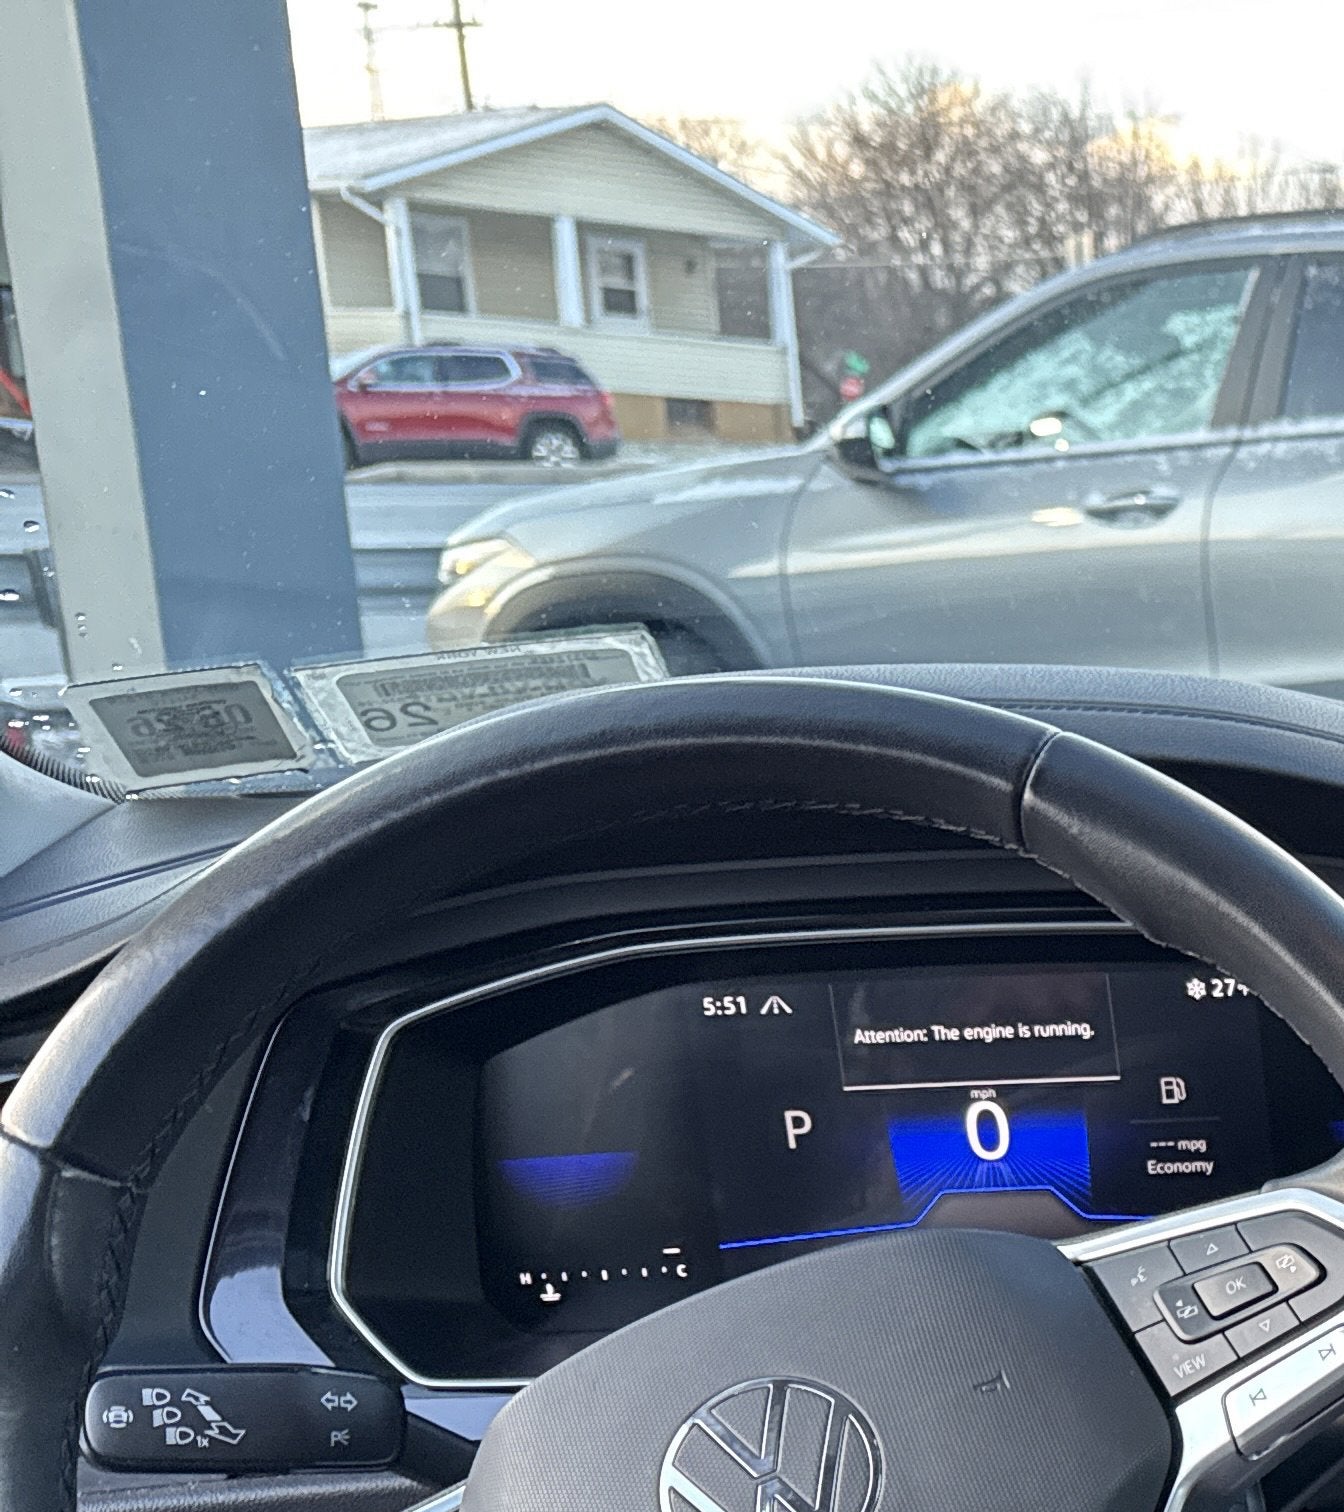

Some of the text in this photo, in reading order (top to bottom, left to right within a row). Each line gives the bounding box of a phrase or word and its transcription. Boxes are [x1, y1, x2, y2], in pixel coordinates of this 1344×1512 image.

[702, 996, 748, 1017] 5:51
[853, 1020, 1096, 1045] Attention: The engine is running.
[970, 1087, 998, 1100] mph
[783, 1109, 813, 1150] P
[966, 1099, 1010, 1161] 0
[1177, 1138, 1208, 1154] mpg
[1146, 1159, 1215, 1176] Economy
[520, 1272, 533, 1285] H
[676, 1263, 689, 1279] C
[1225, 1276, 1247, 1295] OK
[1173, 1353, 1206, 1379] VIEW
